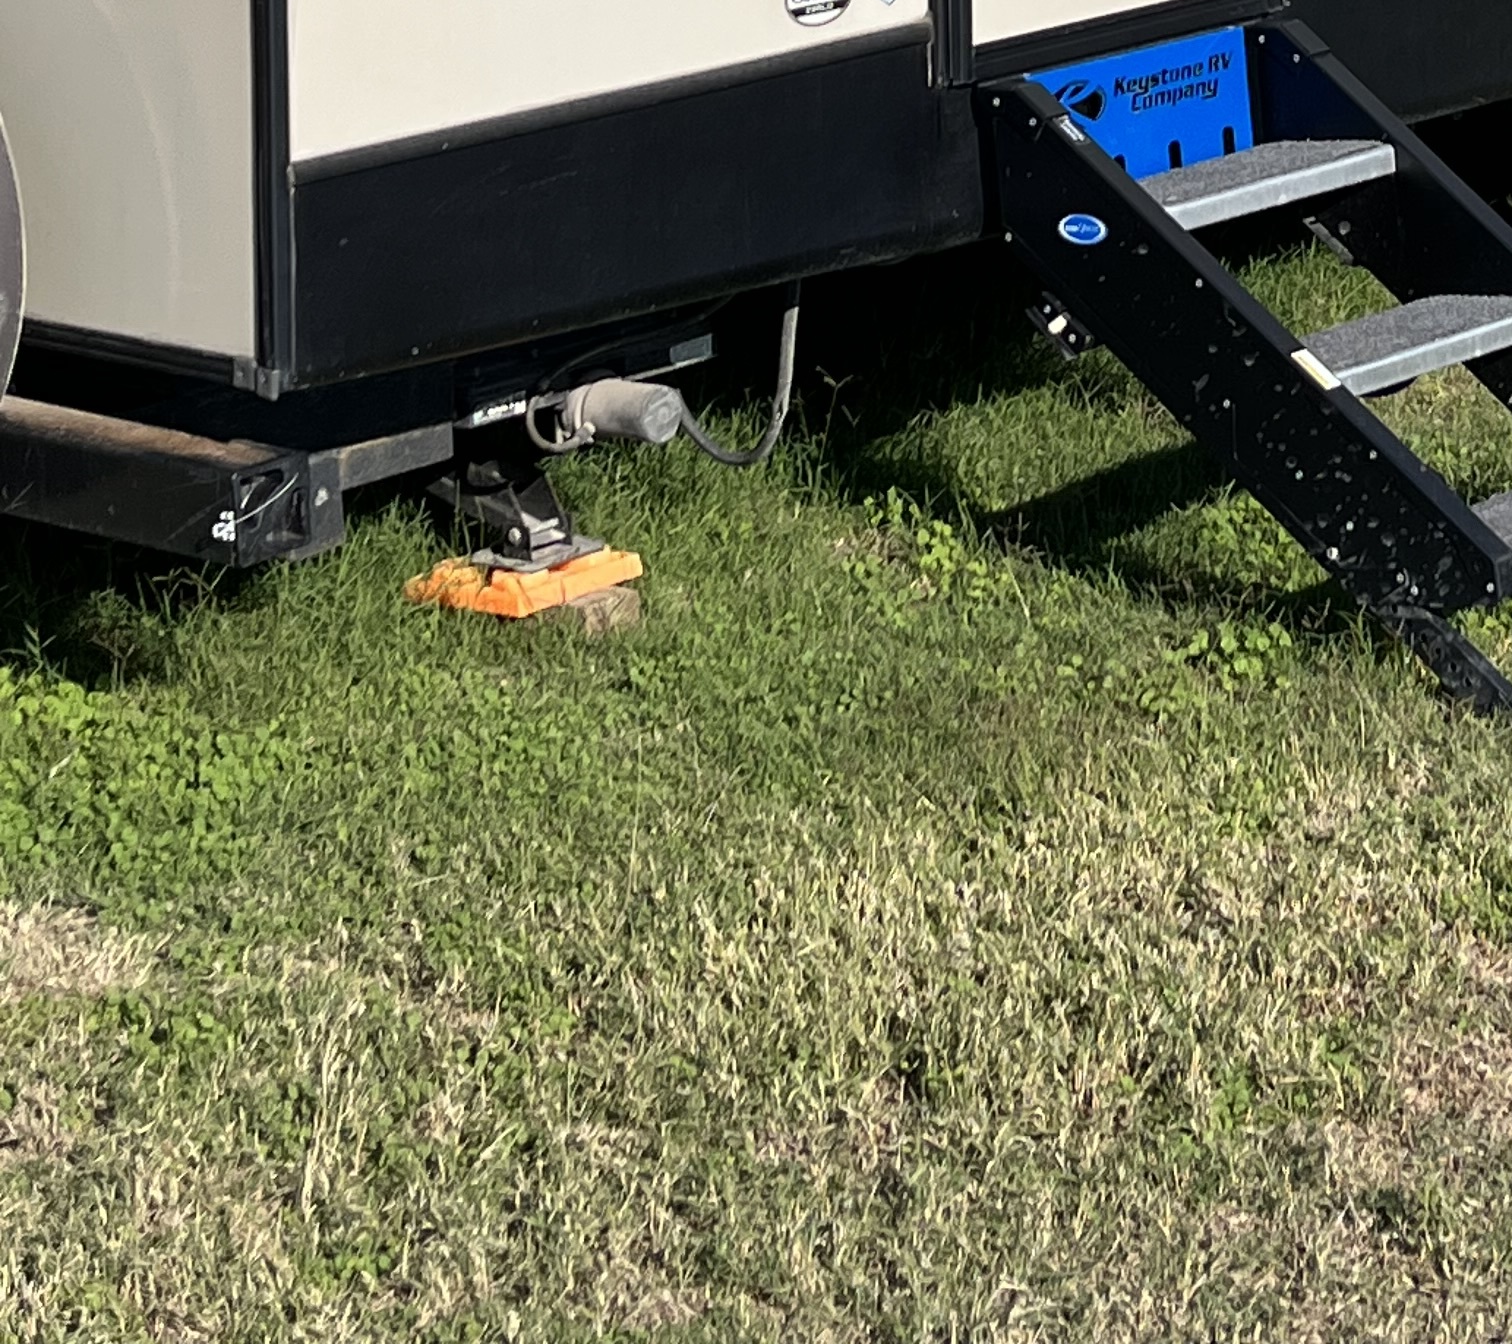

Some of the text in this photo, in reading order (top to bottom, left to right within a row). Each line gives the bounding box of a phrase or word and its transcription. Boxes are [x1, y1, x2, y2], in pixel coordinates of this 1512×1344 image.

[1113, 52, 1233, 98] Keystone RV
[1131, 78, 1219, 113] Company
